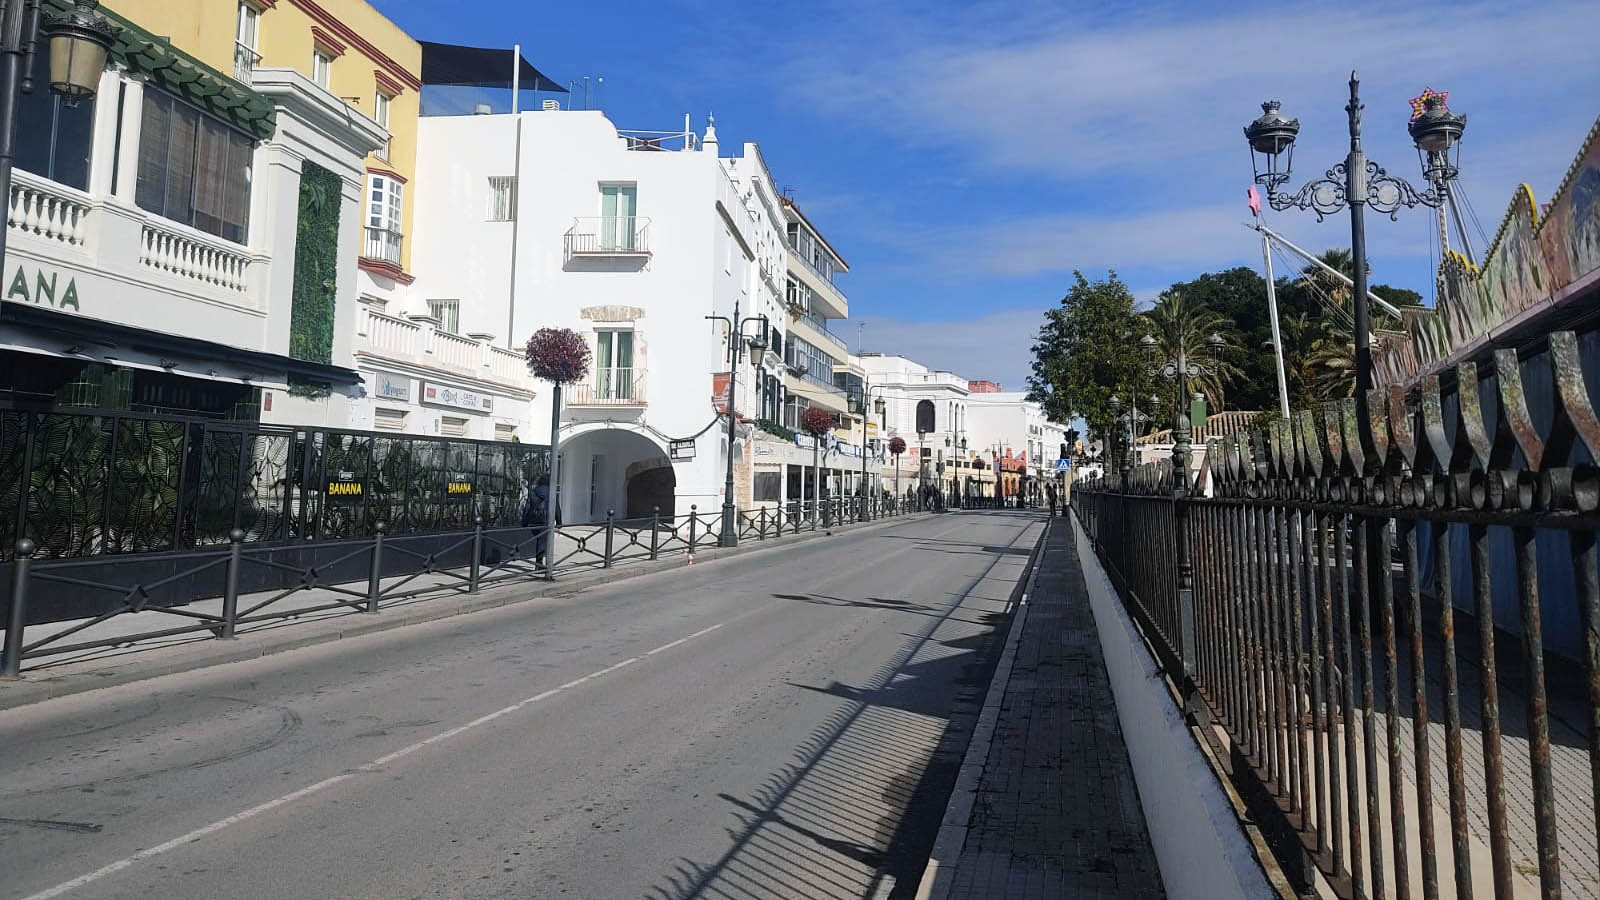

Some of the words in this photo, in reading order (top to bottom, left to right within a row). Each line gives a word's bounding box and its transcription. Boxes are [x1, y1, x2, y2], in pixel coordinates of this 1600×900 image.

[8, 264, 80, 312] ANA
[329, 482, 362, 495] BANANA
[448, 482, 471, 494] BANANA
